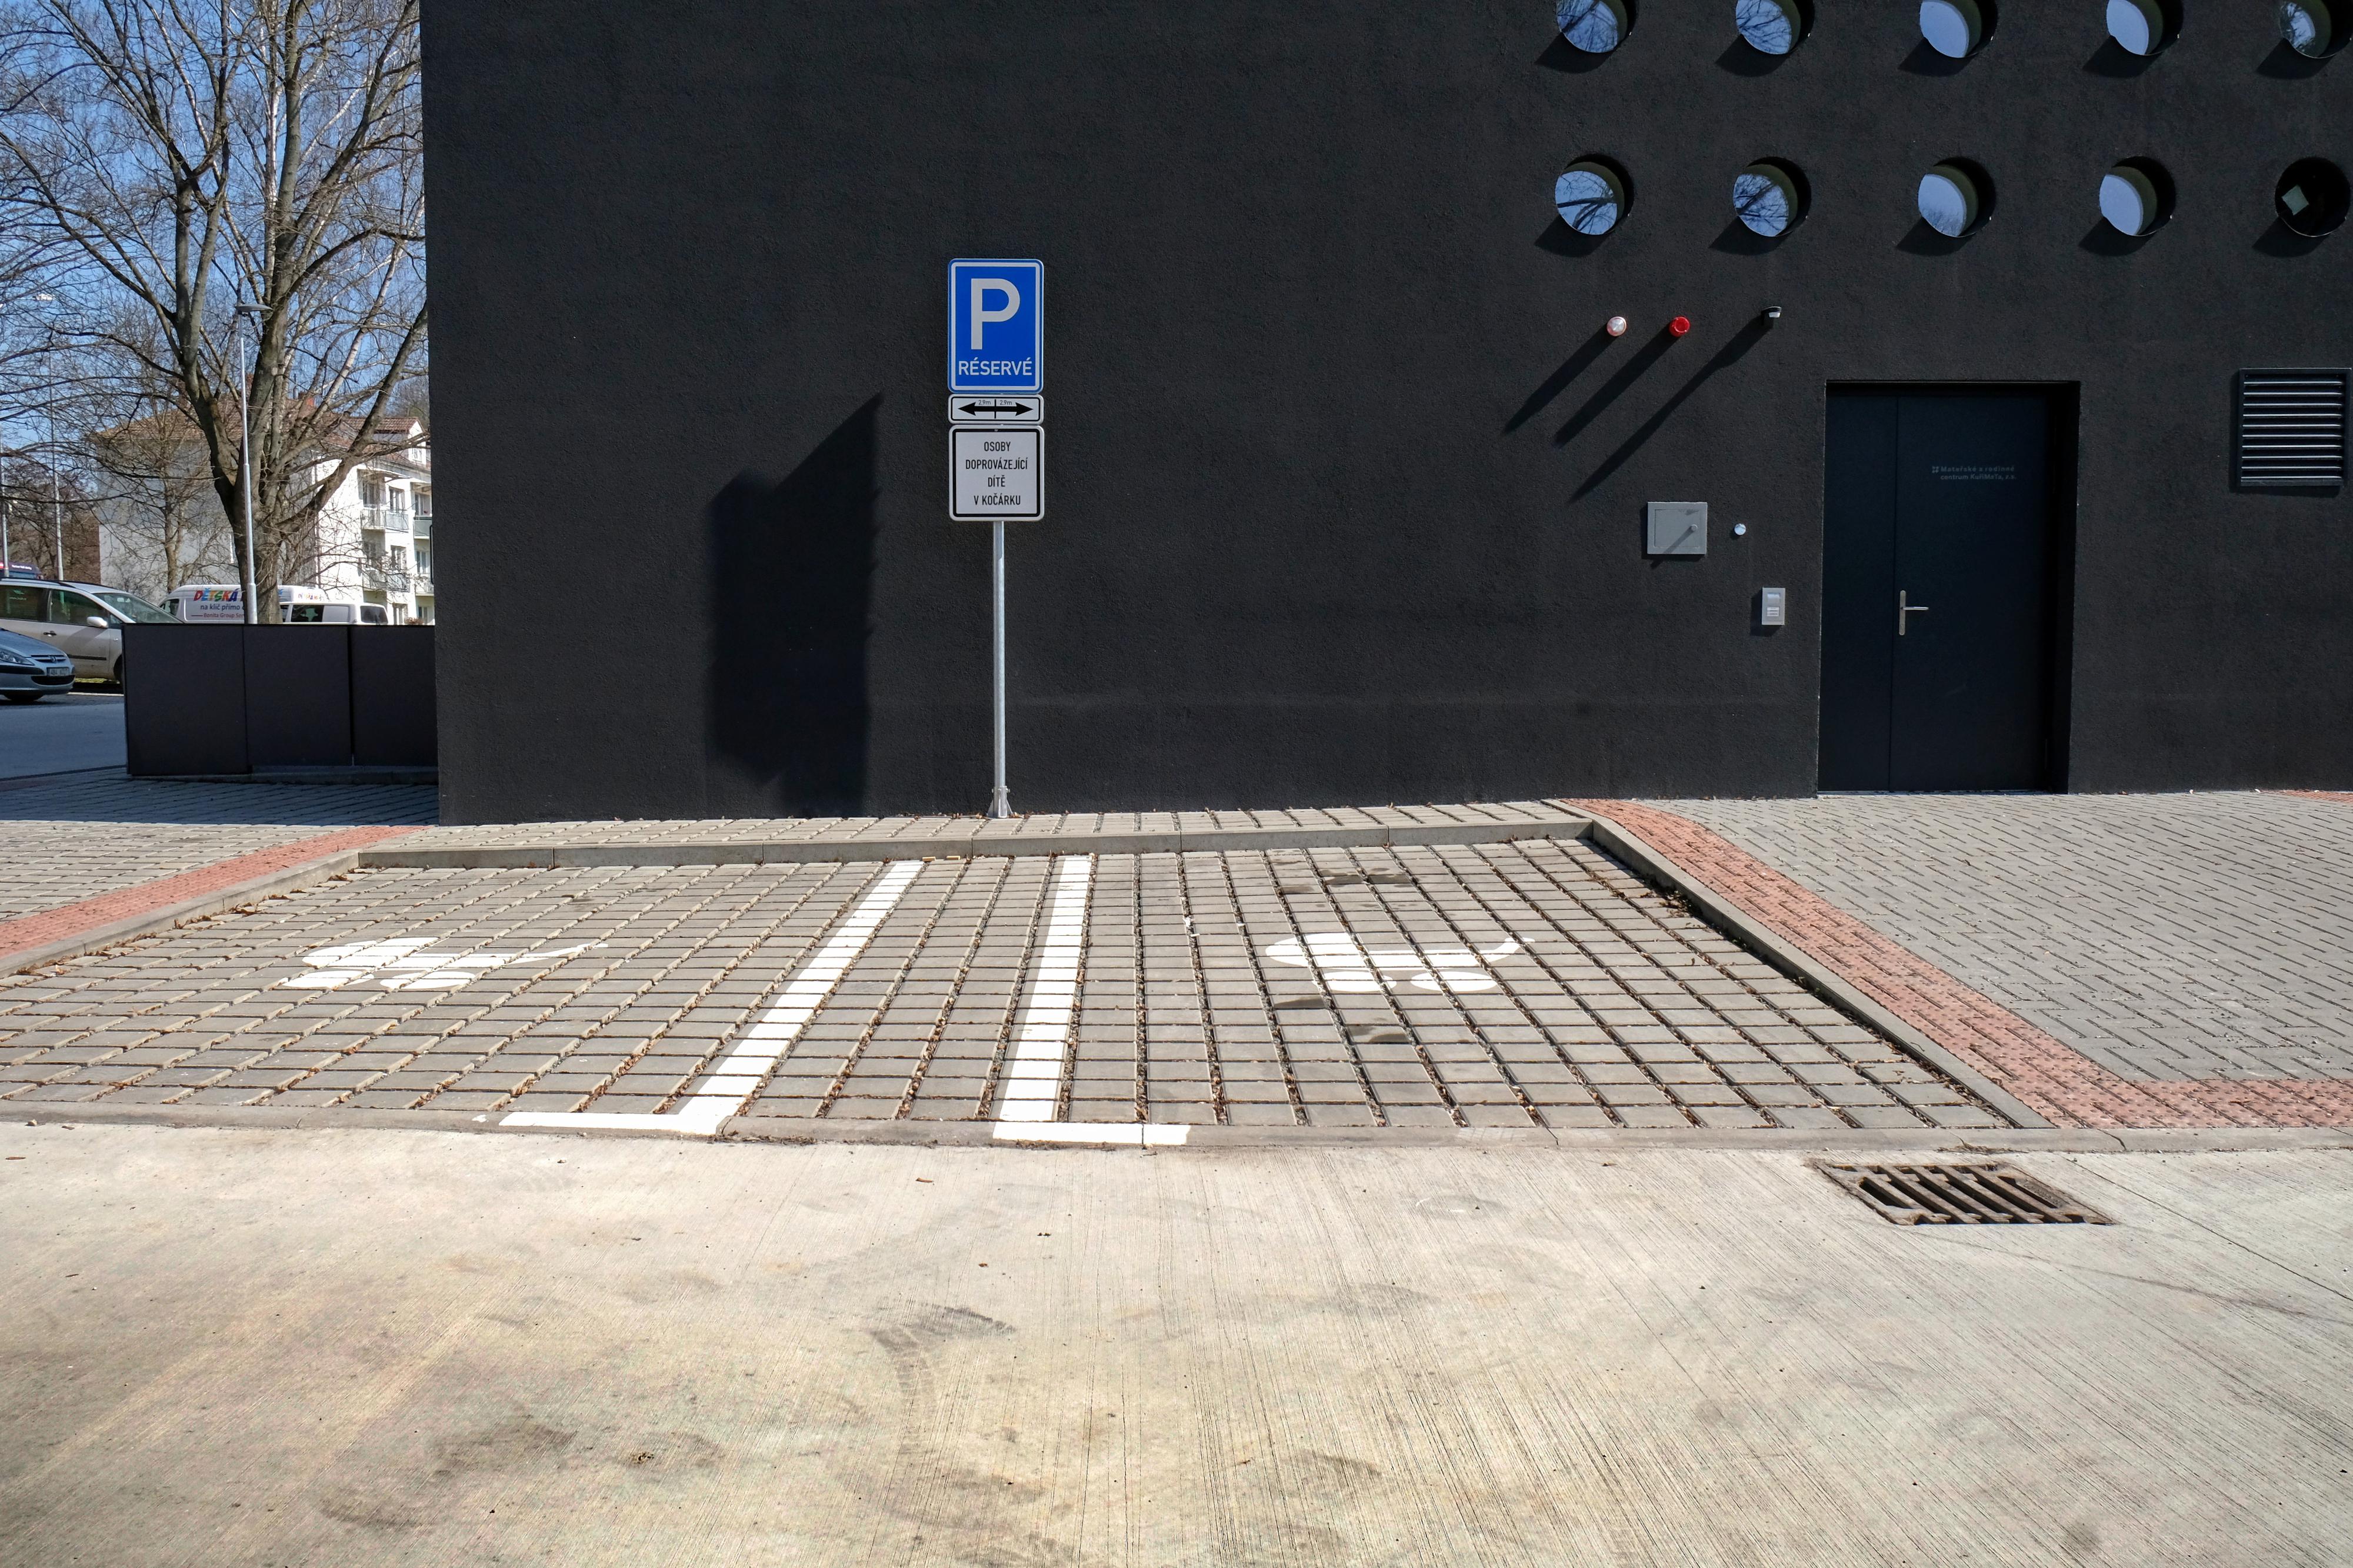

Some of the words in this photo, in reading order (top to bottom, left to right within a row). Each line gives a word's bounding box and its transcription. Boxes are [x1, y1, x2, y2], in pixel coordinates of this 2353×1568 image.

[971, 278, 1021, 350] P
[958, 357, 1033, 376] RÉSERVÉ
[984, 441, 1011, 452] OSOBY
[965, 456, 1028, 470] DOPROVÁZEJÍCÍ
[988, 474, 1006, 488] DÍTĚ
[974, 495, 981, 506] V
[982, 492, 1021, 506] KOČÁRKU
[194, 588, 240, 602] DĚTSKÁ
[221, 603, 241, 612] přímo
